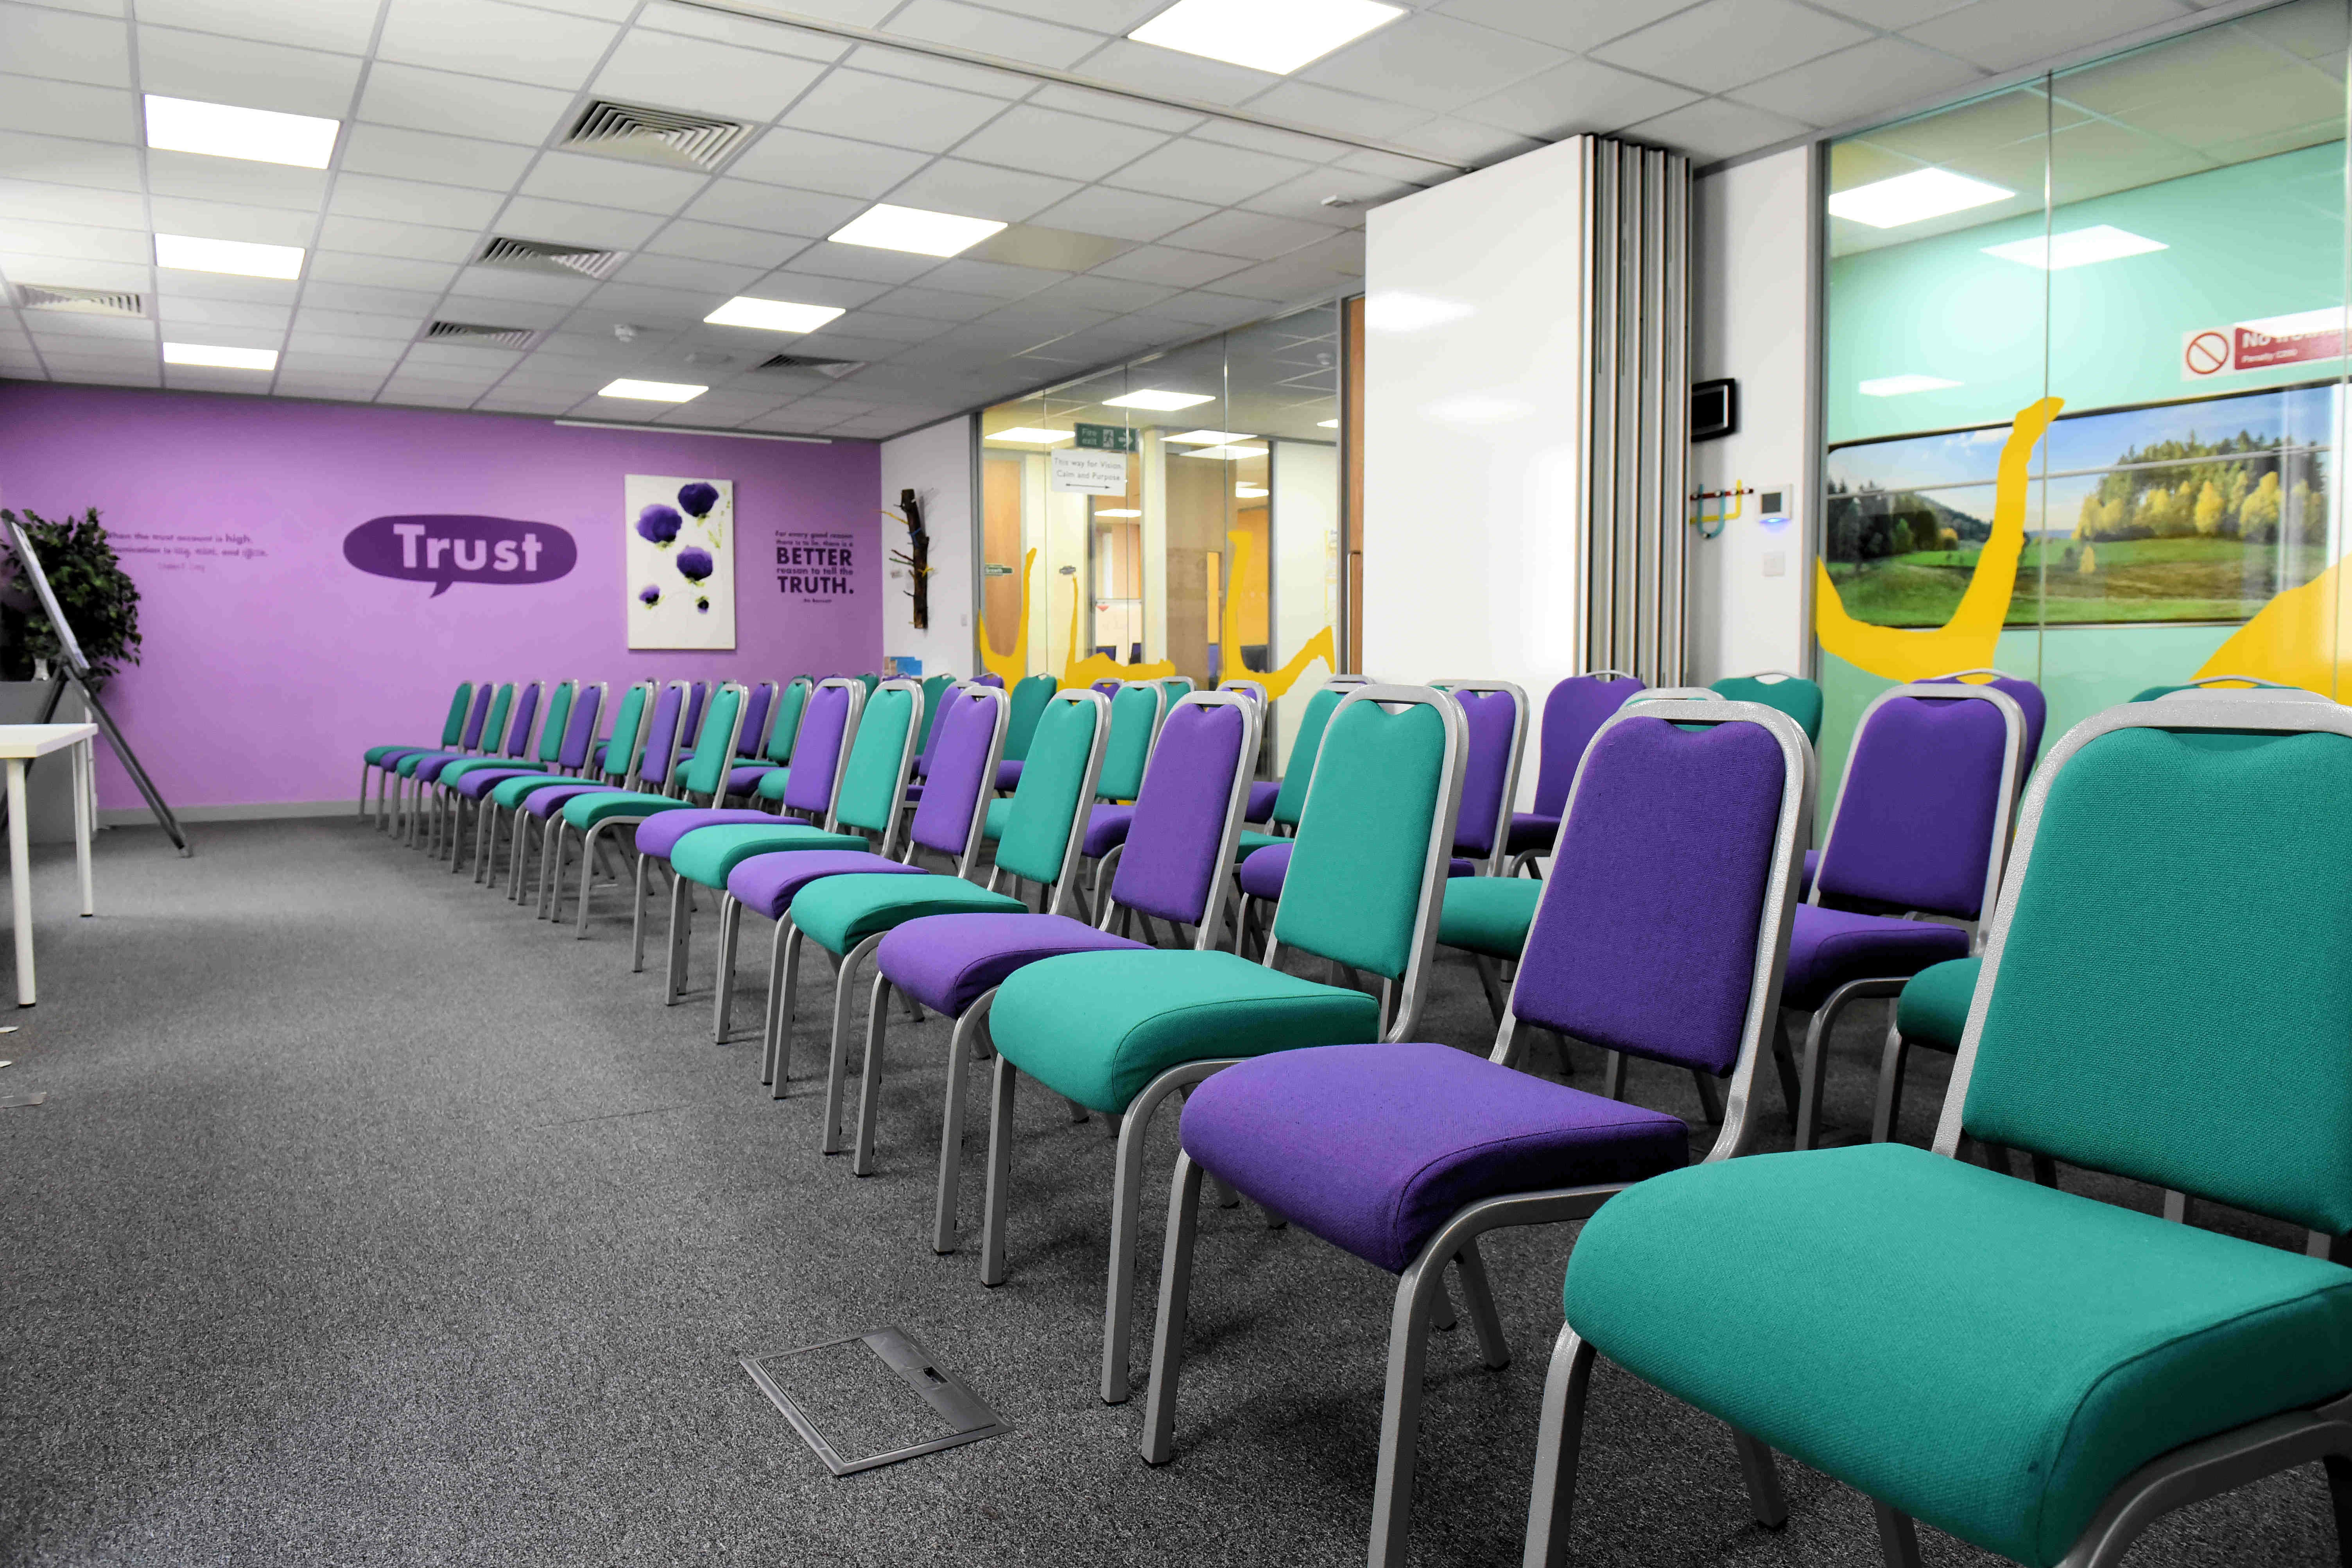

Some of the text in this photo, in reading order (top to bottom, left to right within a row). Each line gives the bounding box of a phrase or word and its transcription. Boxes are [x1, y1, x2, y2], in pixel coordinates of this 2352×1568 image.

[1082, 428, 1097, 437] Fire
[1081, 437, 1097, 446] exit
[1092, 472, 1120, 482] Purpose
[393, 523, 543, 572] Trust
[776, 547, 853, 566] BETTER
[840, 567, 854, 575] the
[777, 576, 854, 594] TRUTH.
